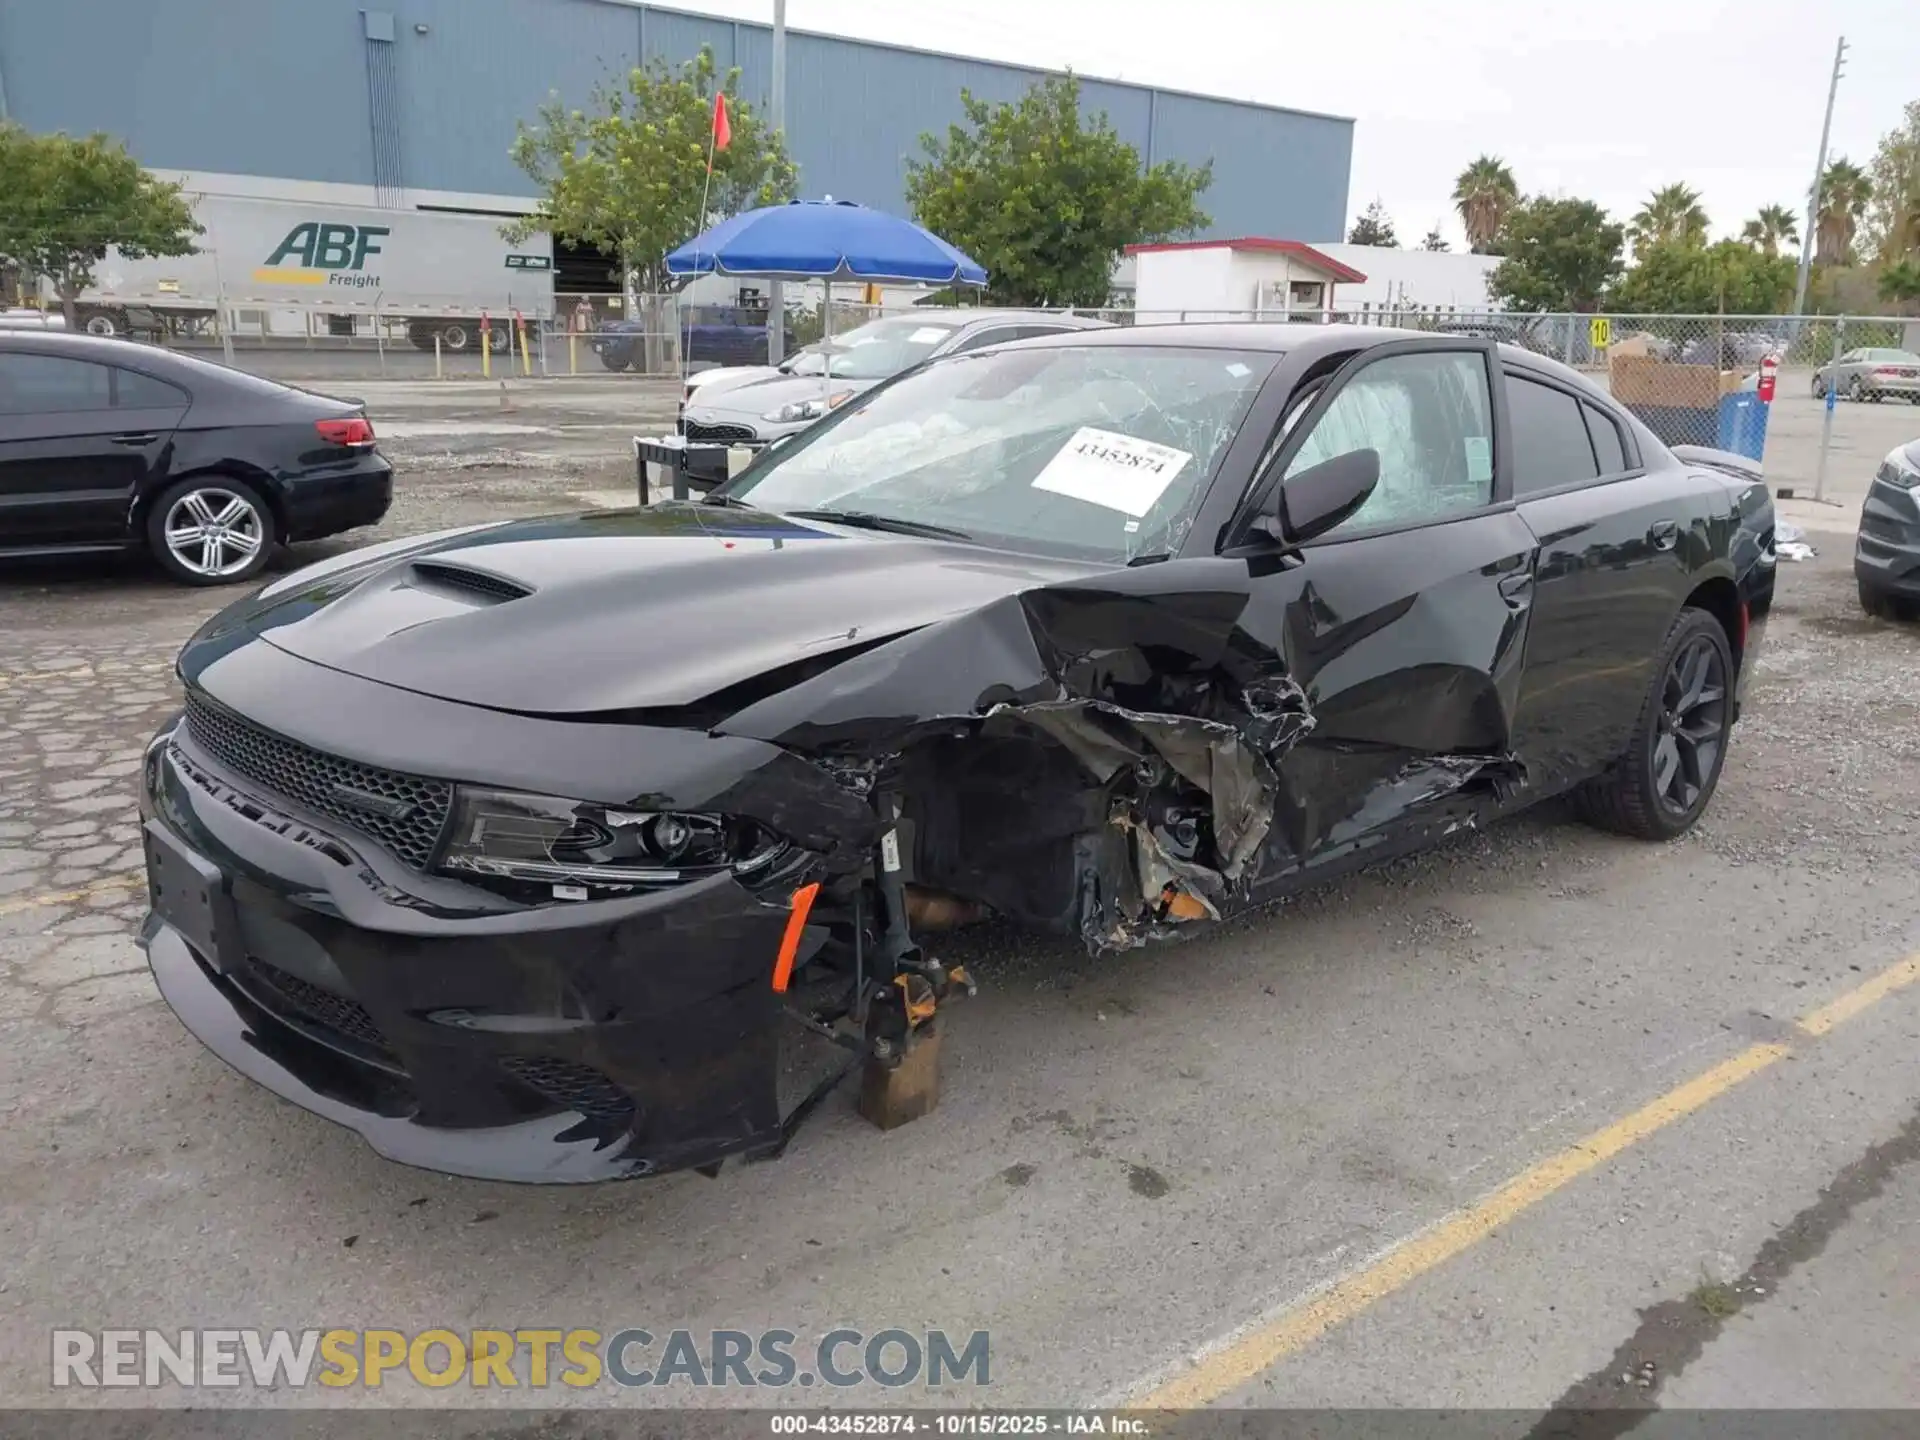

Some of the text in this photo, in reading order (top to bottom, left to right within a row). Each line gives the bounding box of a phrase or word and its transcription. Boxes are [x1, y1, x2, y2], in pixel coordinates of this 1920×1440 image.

[263, 221, 391, 270] ABF
[328, 272, 382, 289] Freight
[1594, 321, 1608, 343] 10
[1075, 442, 1166, 475] 43452874
